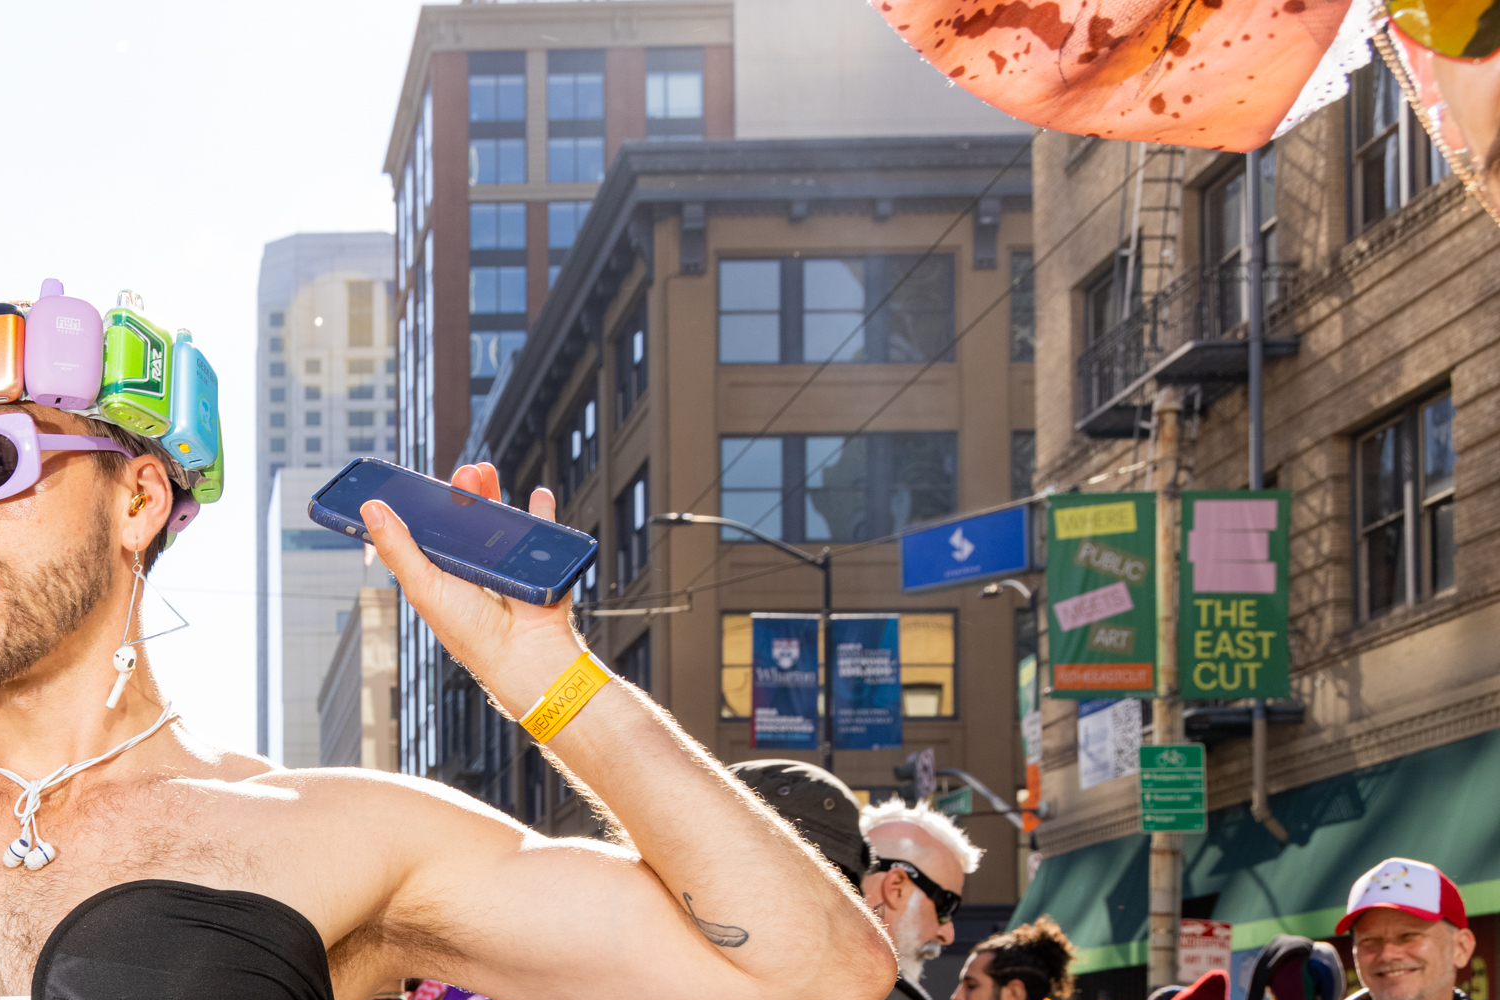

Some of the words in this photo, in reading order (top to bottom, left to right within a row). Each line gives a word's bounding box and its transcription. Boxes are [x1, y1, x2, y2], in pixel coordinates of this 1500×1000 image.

[57, 317, 80, 330] FLUM
[151, 348, 162, 382] RAZ
[197, 358, 210, 377] GEEK
[1061, 508, 1129, 532] WHERE
[1078, 541, 1145, 581] PUBLIC
[1062, 587, 1128, 620] MEETS
[1193, 599, 1257, 628] THE
[1093, 628, 1131, 649] ART
[1194, 631, 1277, 659] EAST
[755, 667, 816, 683] Wharton
[1193, 662, 1263, 690] CUT
[1205, 954, 1226, 967] TIME
